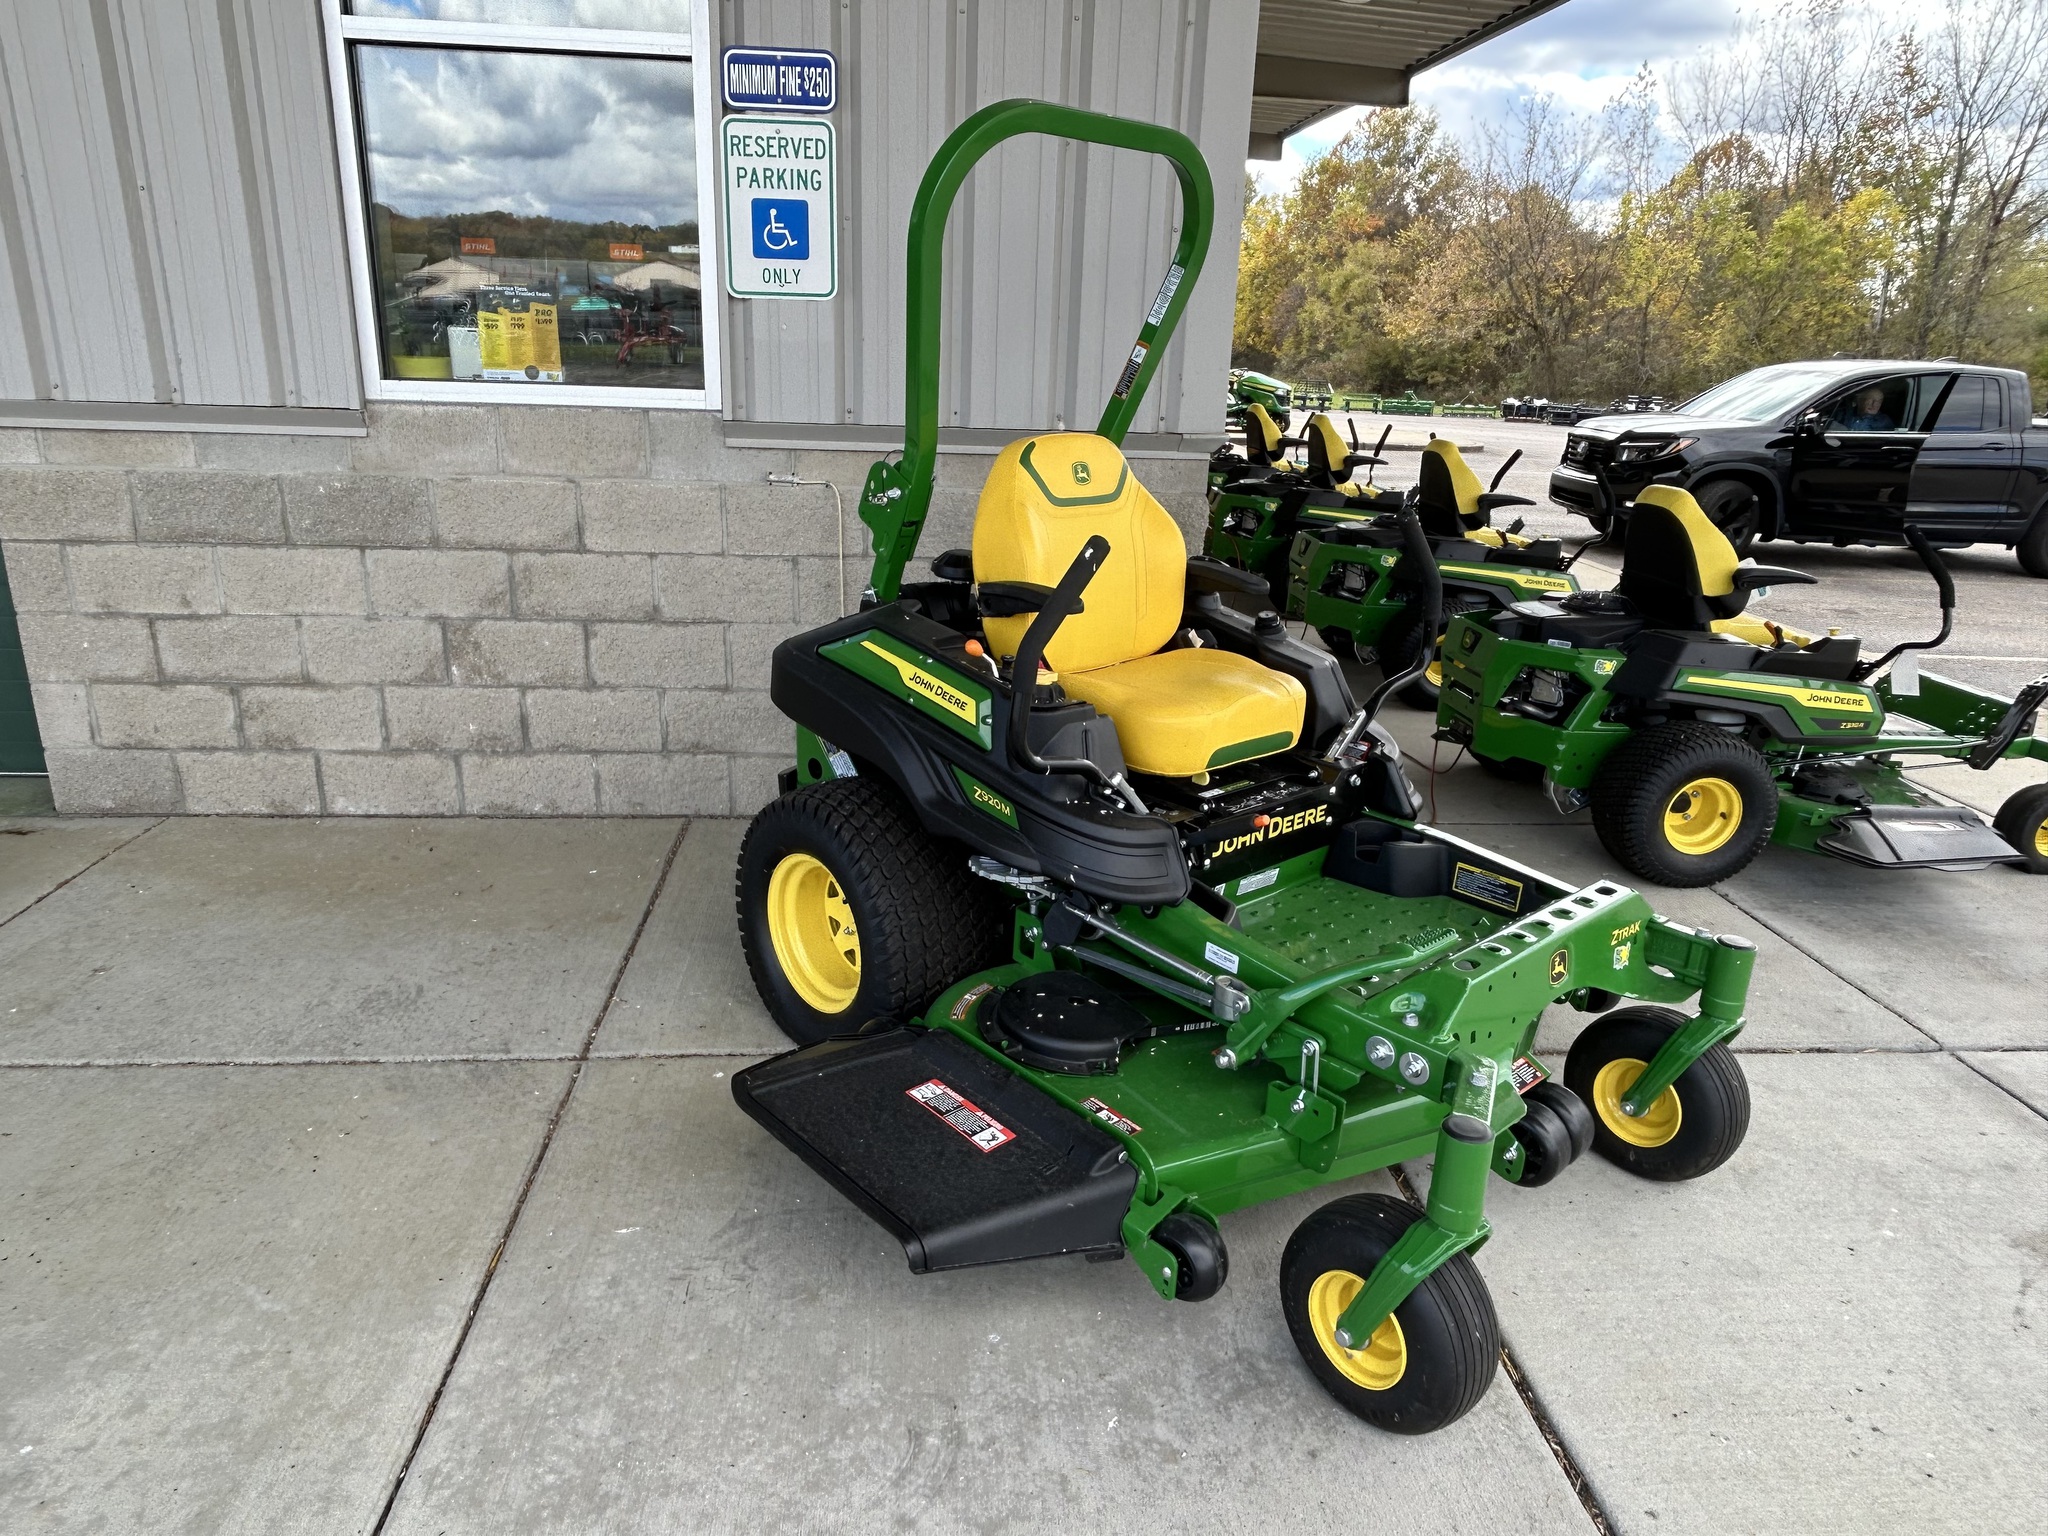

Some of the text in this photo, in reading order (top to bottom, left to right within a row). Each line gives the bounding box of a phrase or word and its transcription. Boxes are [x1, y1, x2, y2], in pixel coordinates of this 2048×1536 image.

[730, 63, 830, 98] MINIMUM FINE $250
[730, 134, 826, 160] RESERVED
[736, 167, 822, 191] PARKING
[465, 242, 491, 251] STIHL
[614, 248, 639, 257] STIHL
[763, 267, 801, 284] ONLY
[909, 672, 968, 711] JOHN DEERE
[1807, 693, 1864, 706] JOHN DEERE
[973, 786, 1011, 816] Z920M
[1268, 804, 1328, 839] DEERE
[1611, 920, 1641, 946] ZTRAK
